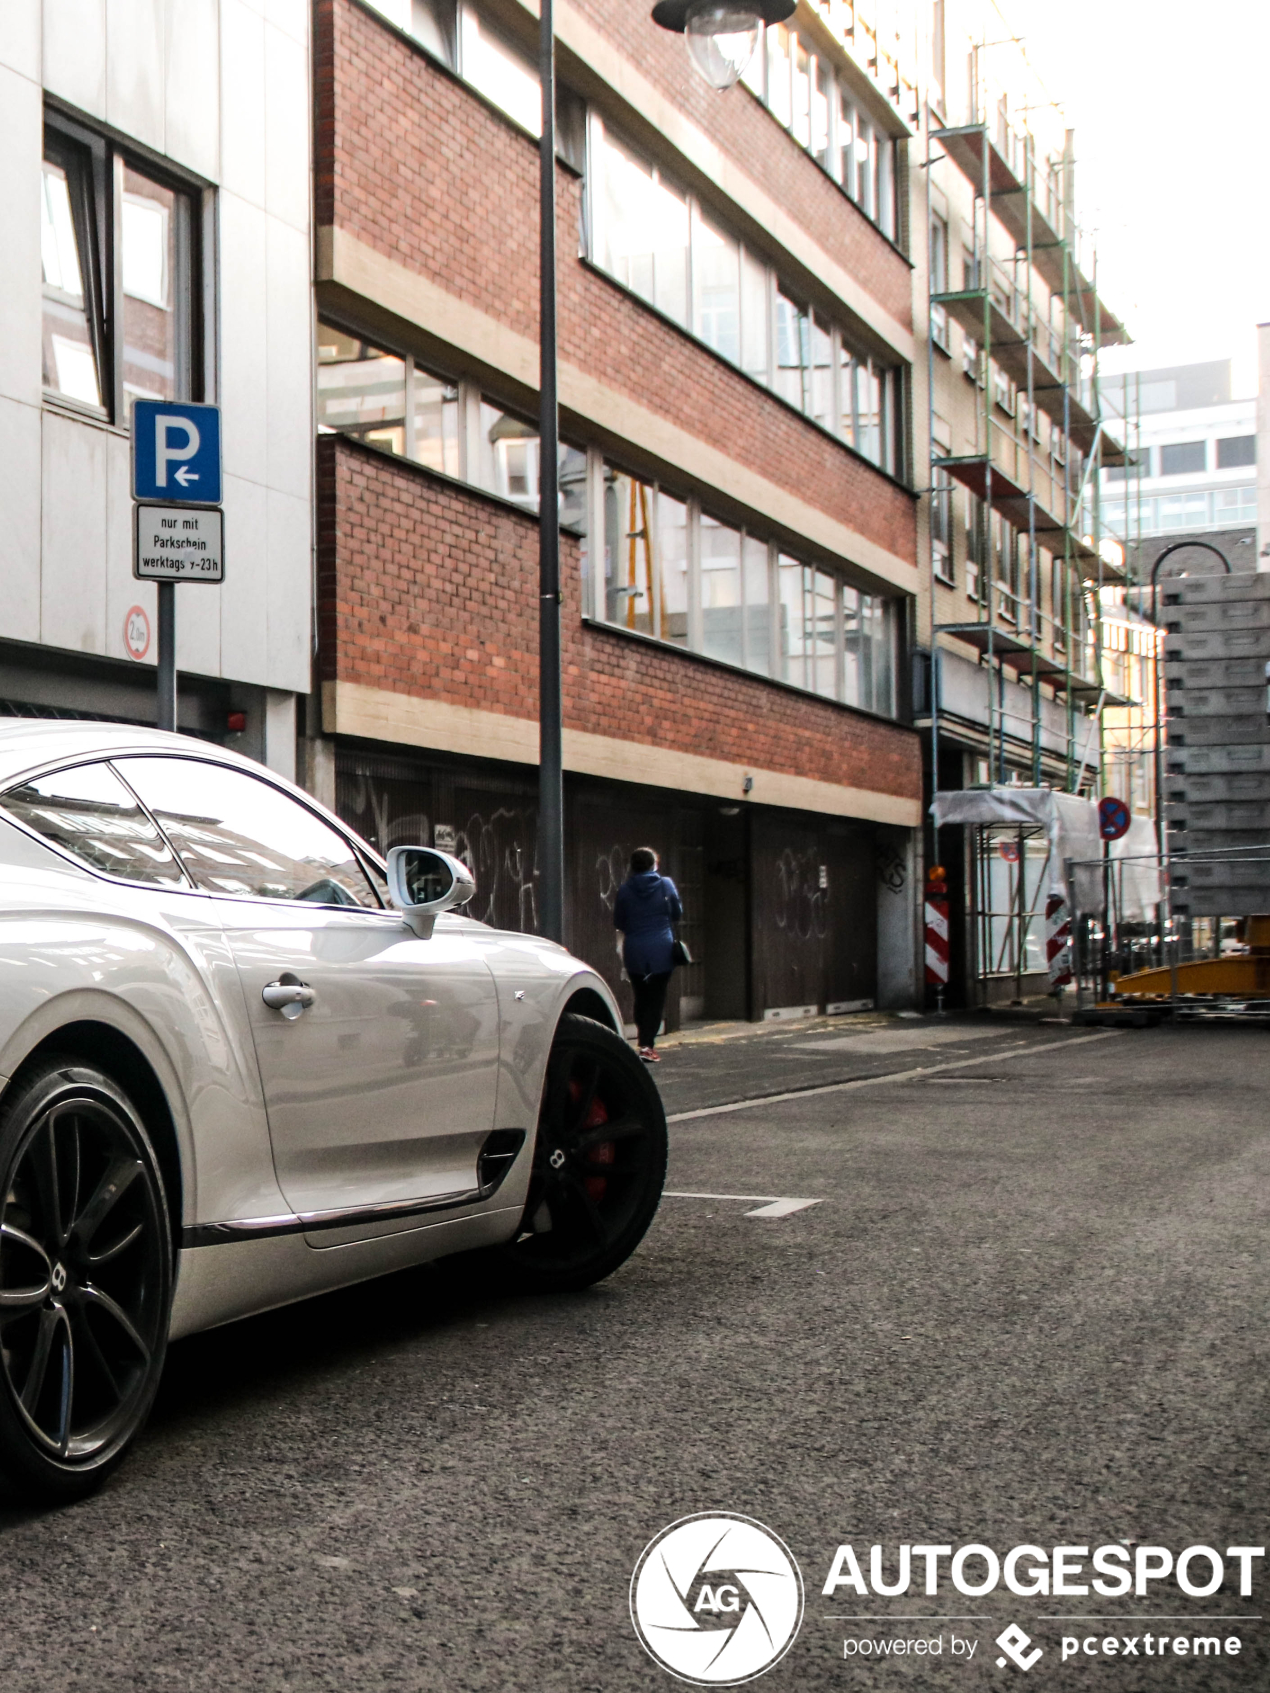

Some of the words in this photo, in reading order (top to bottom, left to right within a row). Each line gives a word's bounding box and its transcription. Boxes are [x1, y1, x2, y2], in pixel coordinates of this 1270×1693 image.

[155, 414, 200, 487] P
[161, 518, 178, 529] nur
[182, 517, 199, 531] mit
[153, 534, 207, 551] Parkschein
[142, 555, 185, 572] werktags
